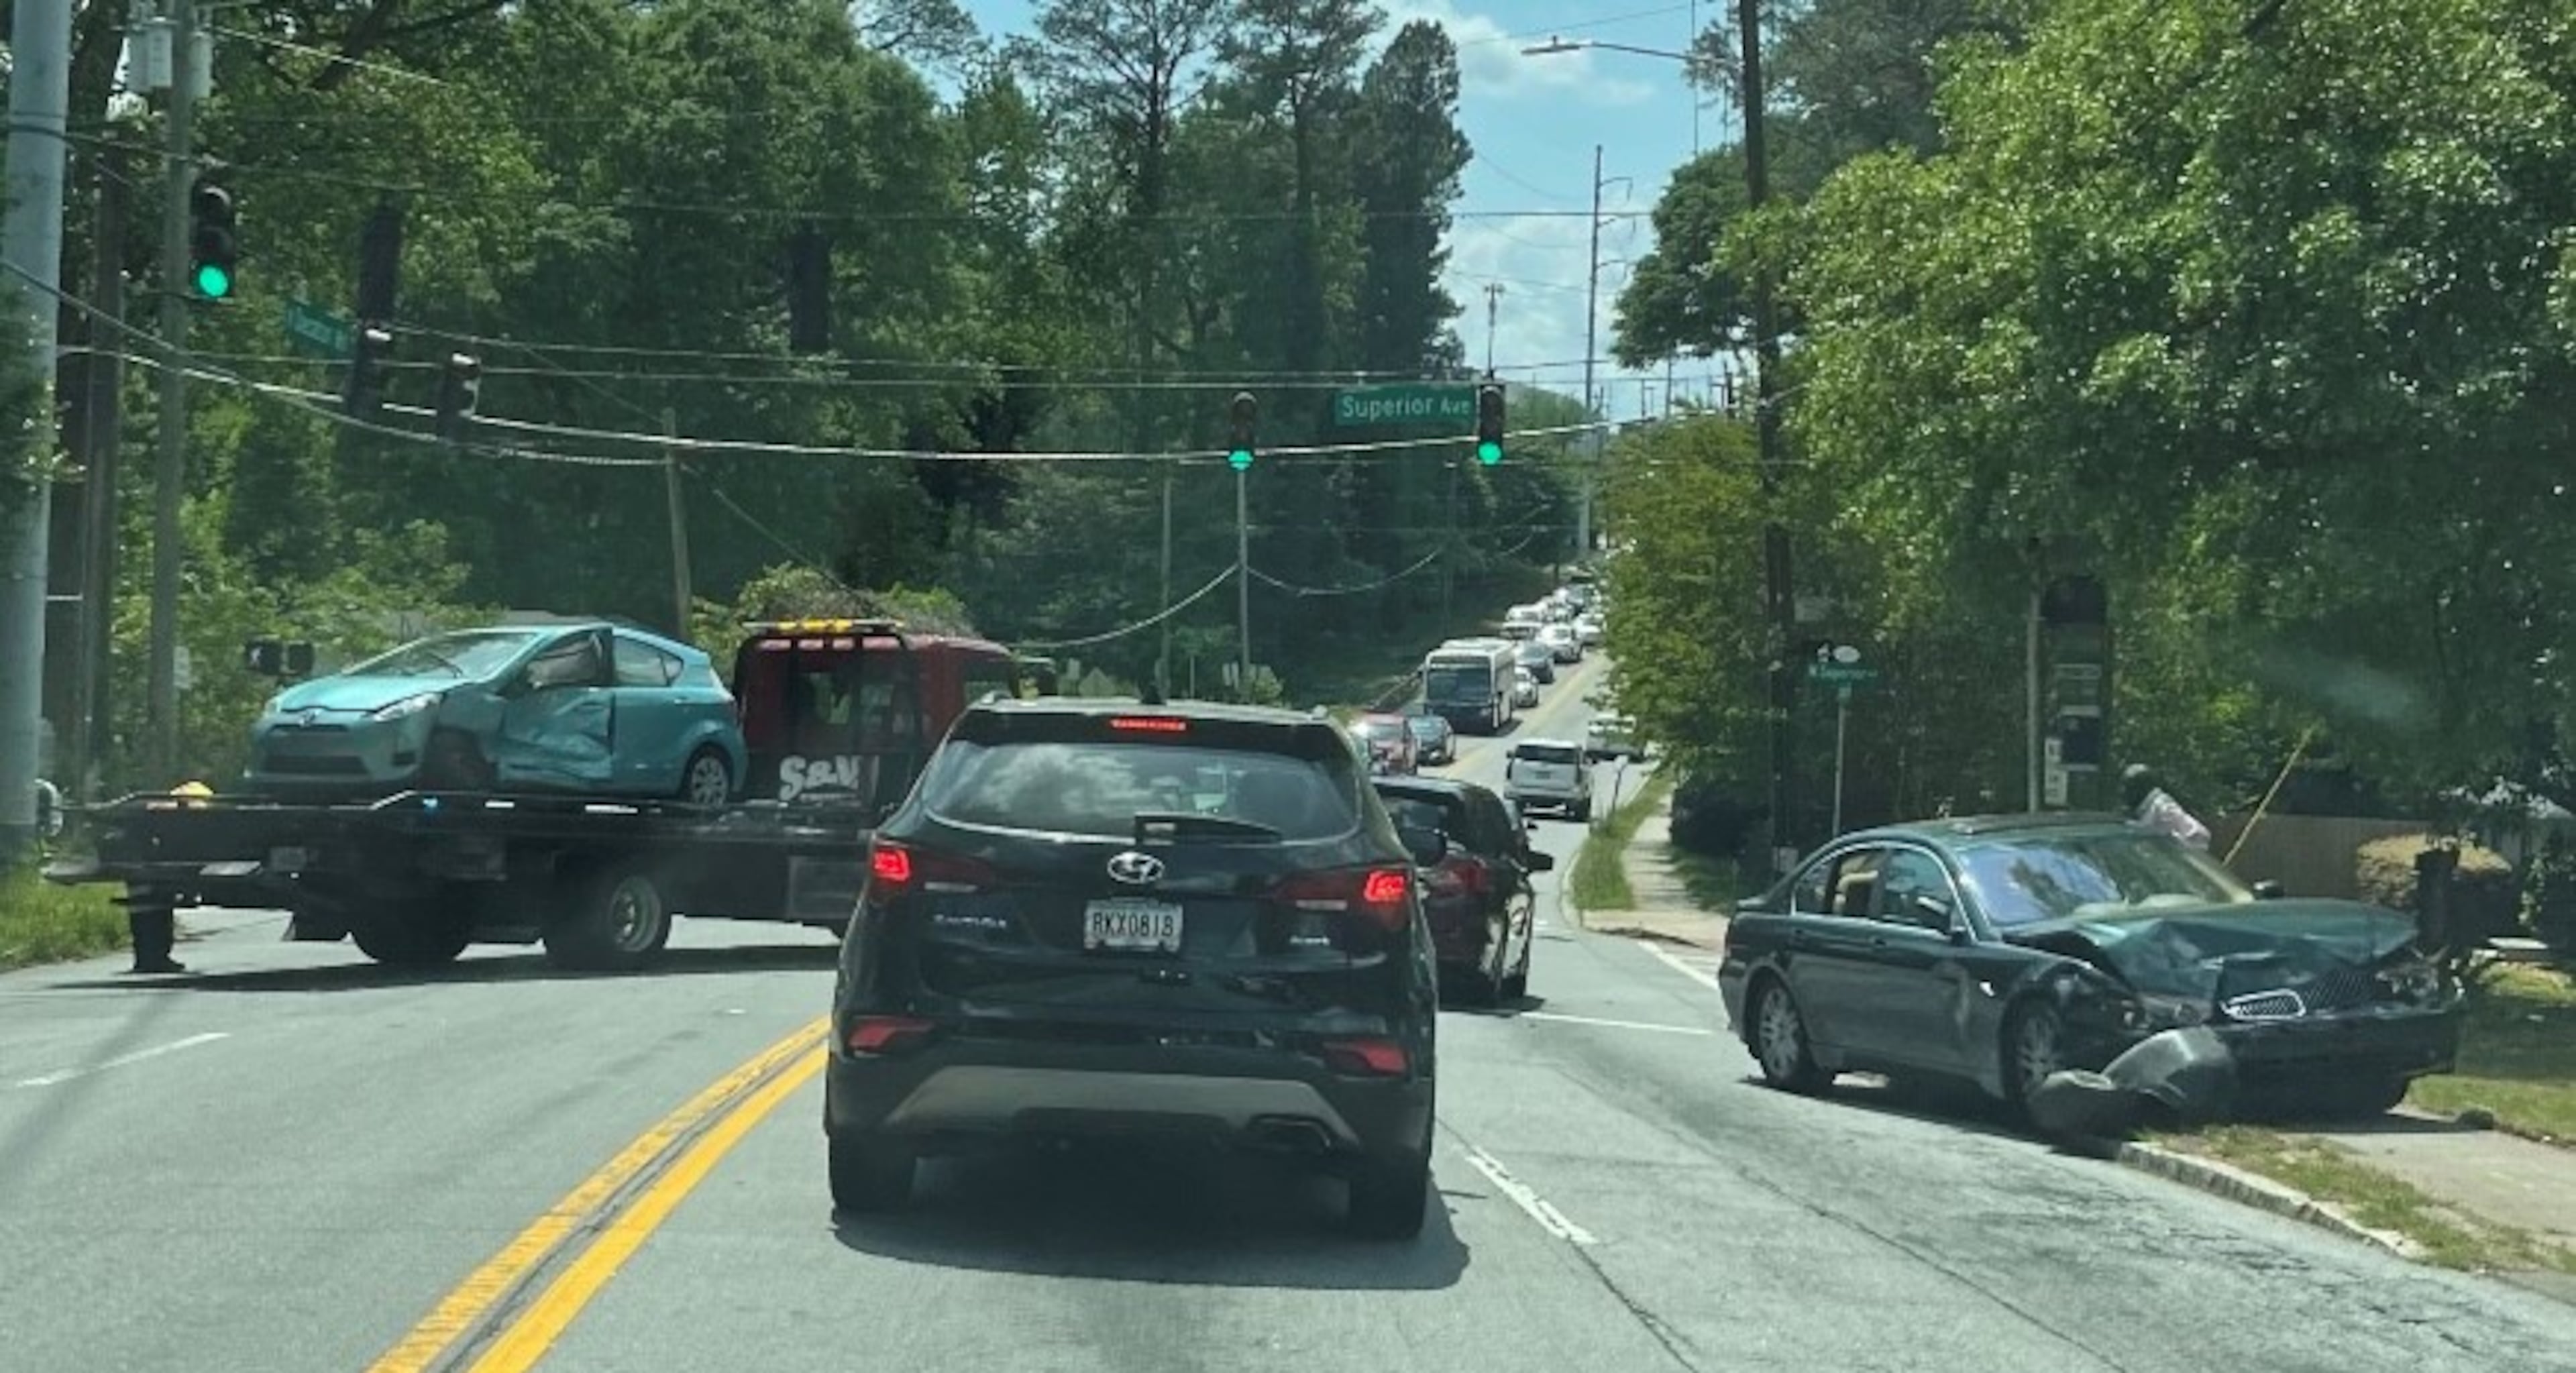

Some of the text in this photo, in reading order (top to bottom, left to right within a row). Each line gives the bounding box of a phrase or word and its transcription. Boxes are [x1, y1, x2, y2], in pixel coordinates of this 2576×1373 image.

[1342, 394, 1471, 422] Superior Ave
[1093, 912, 1173, 937] RKX0818
